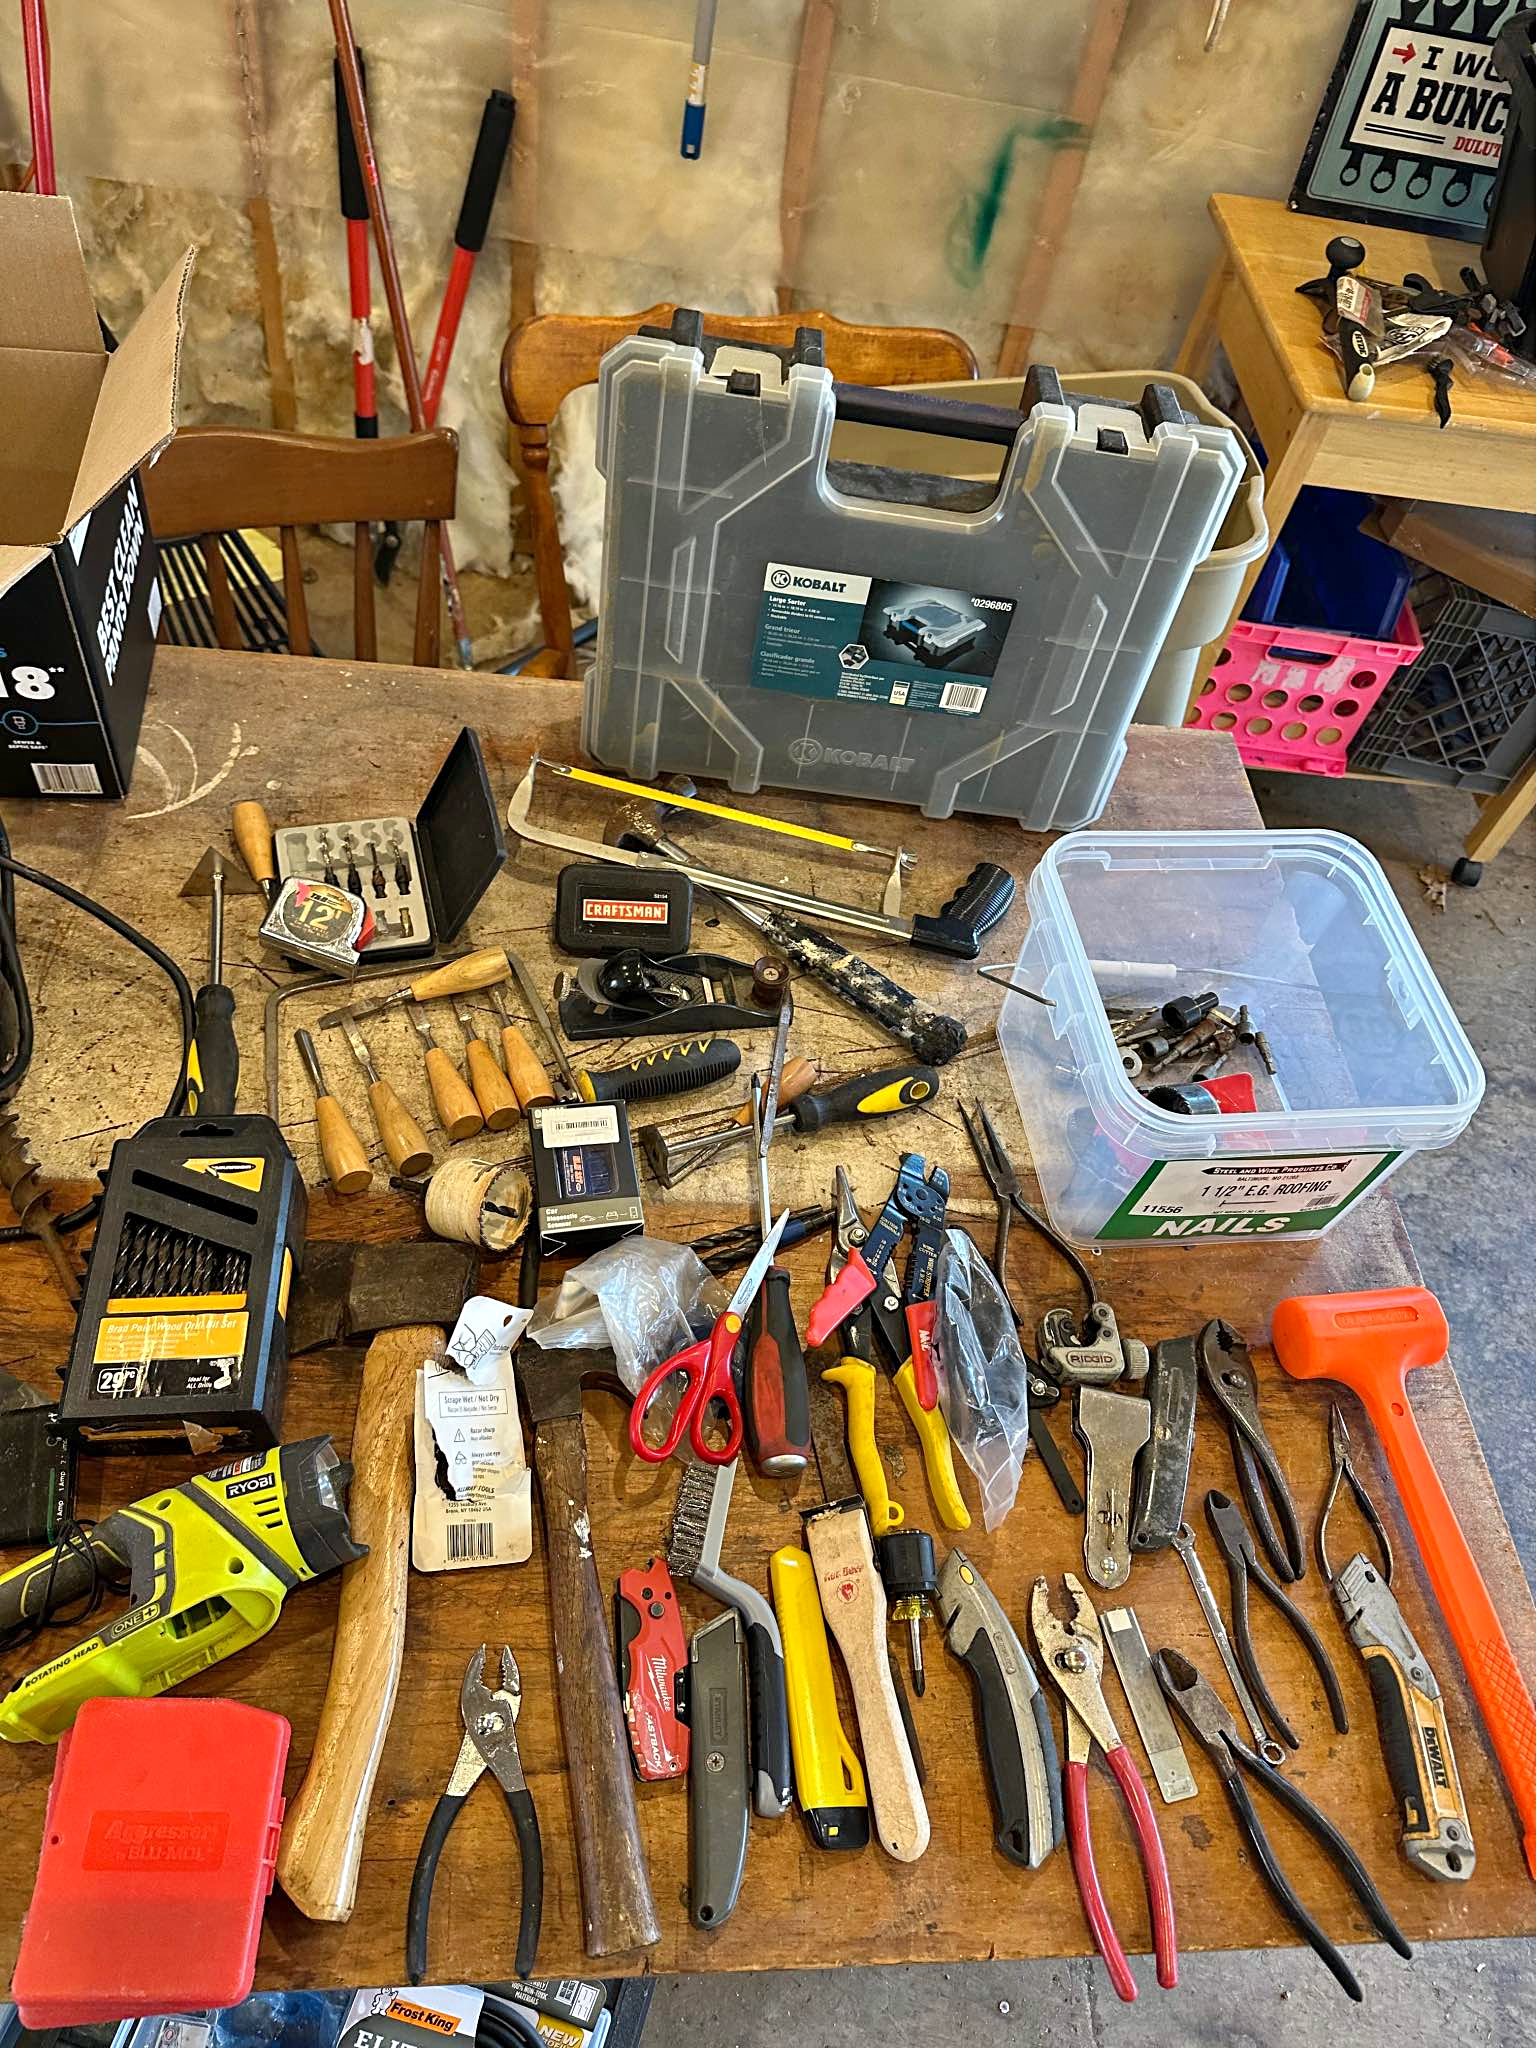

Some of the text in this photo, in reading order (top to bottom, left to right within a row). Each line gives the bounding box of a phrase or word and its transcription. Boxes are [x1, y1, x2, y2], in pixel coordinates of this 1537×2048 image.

[1421, 45, 1444, 70] I
[1370, 71, 1406, 116] A
[97, 477, 139, 659] BEST CLEAN
[793, 576, 847, 593] KOBALT
[104, 510, 144, 687] PANTS DOWN
[971, 597, 1013, 612] #0296805
[824, 747, 915, 773] KOBALT
[586, 903, 665, 918] CRAFTSMAN
[1282, 1165, 1325, 1173] PRODUCTS
[1201, 1185, 1212, 1197] 1
[1244, 1184, 1270, 1197] E.G.
[1273, 1180, 1332, 1195] ROOFING
[1141, 1204, 1184, 1215] 11556
[1151, 1216, 1291, 1237] NAILS
[1070, 1355, 1114, 1363] RIDGID
[100, 1371, 123, 1390] 29
[489, 1394, 500, 1402] Dry
[228, 1476, 274, 1496] RYOBI
[25, 1642, 99, 1688] ROTATING HEAD
[651, 1654, 672, 1712] Milwaukee
[644, 1711, 663, 1769] FASTBACK
[1423, 1727, 1447, 1788] DEWALT
[390, 2002, 454, 2032] Frost King
[539, 2024, 581, 2047] NEW
